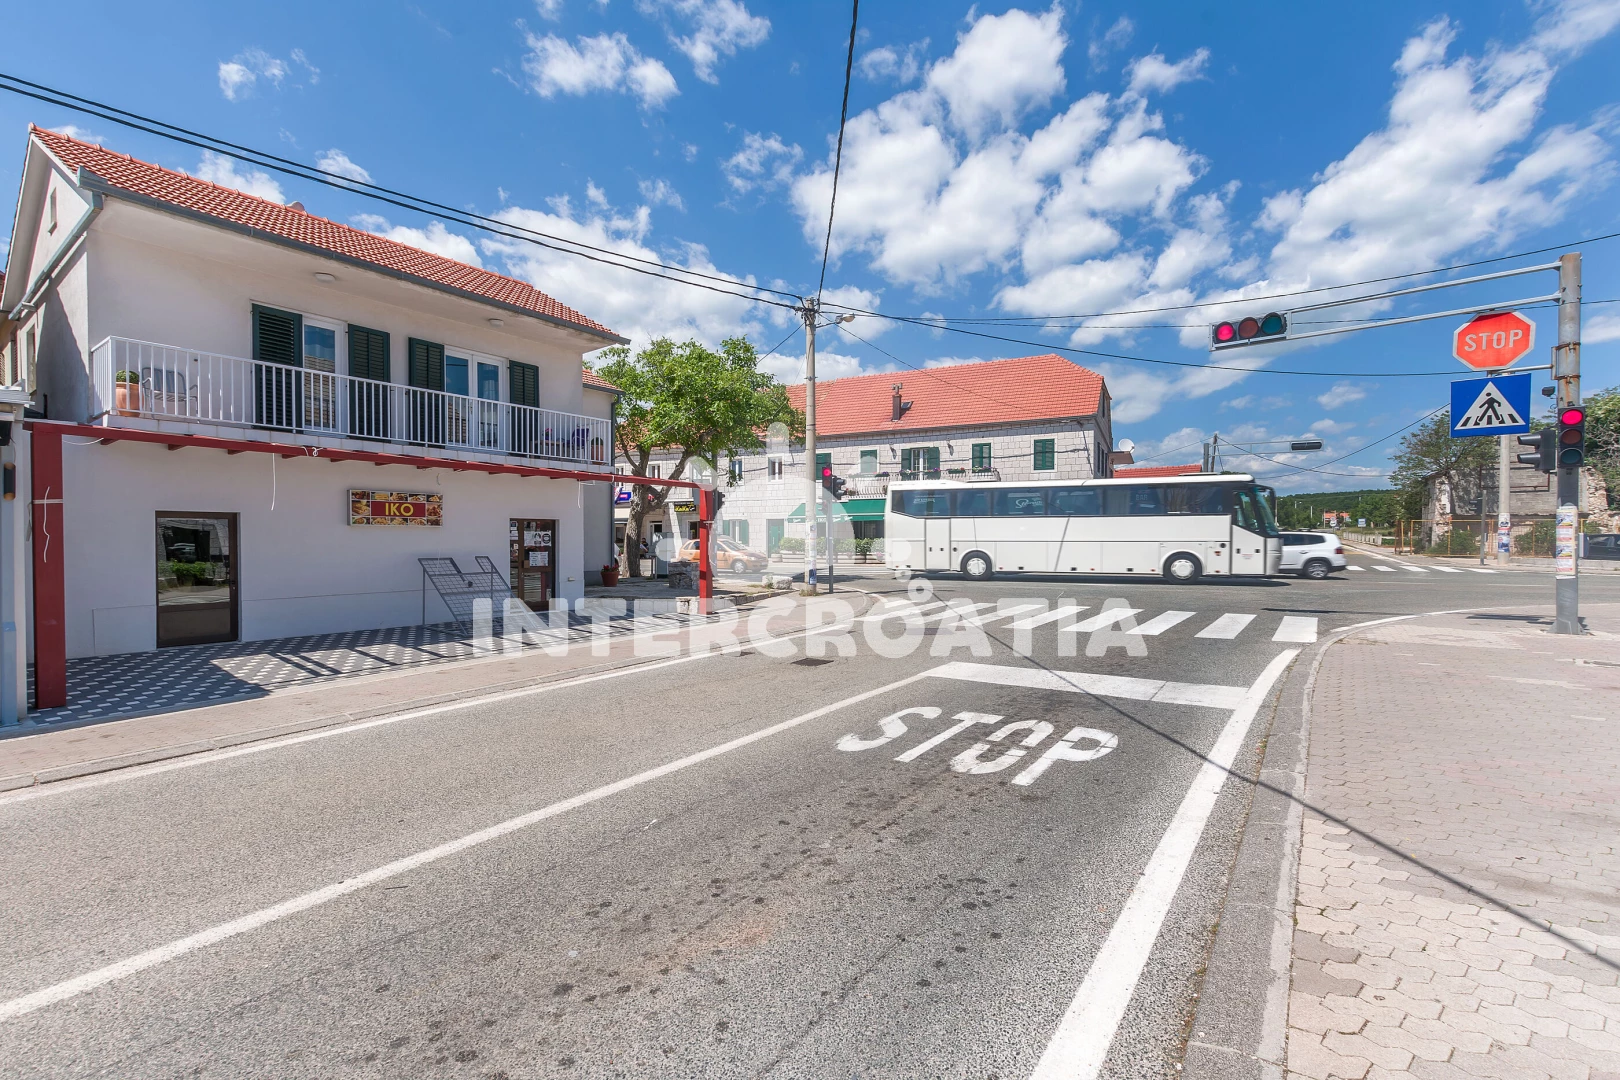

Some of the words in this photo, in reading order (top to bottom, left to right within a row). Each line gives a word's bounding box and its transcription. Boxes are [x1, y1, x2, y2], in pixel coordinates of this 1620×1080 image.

[1464, 329, 1523, 352] STOP
[385, 502, 414, 516] IKO
[835, 706, 1119, 787] STOP
